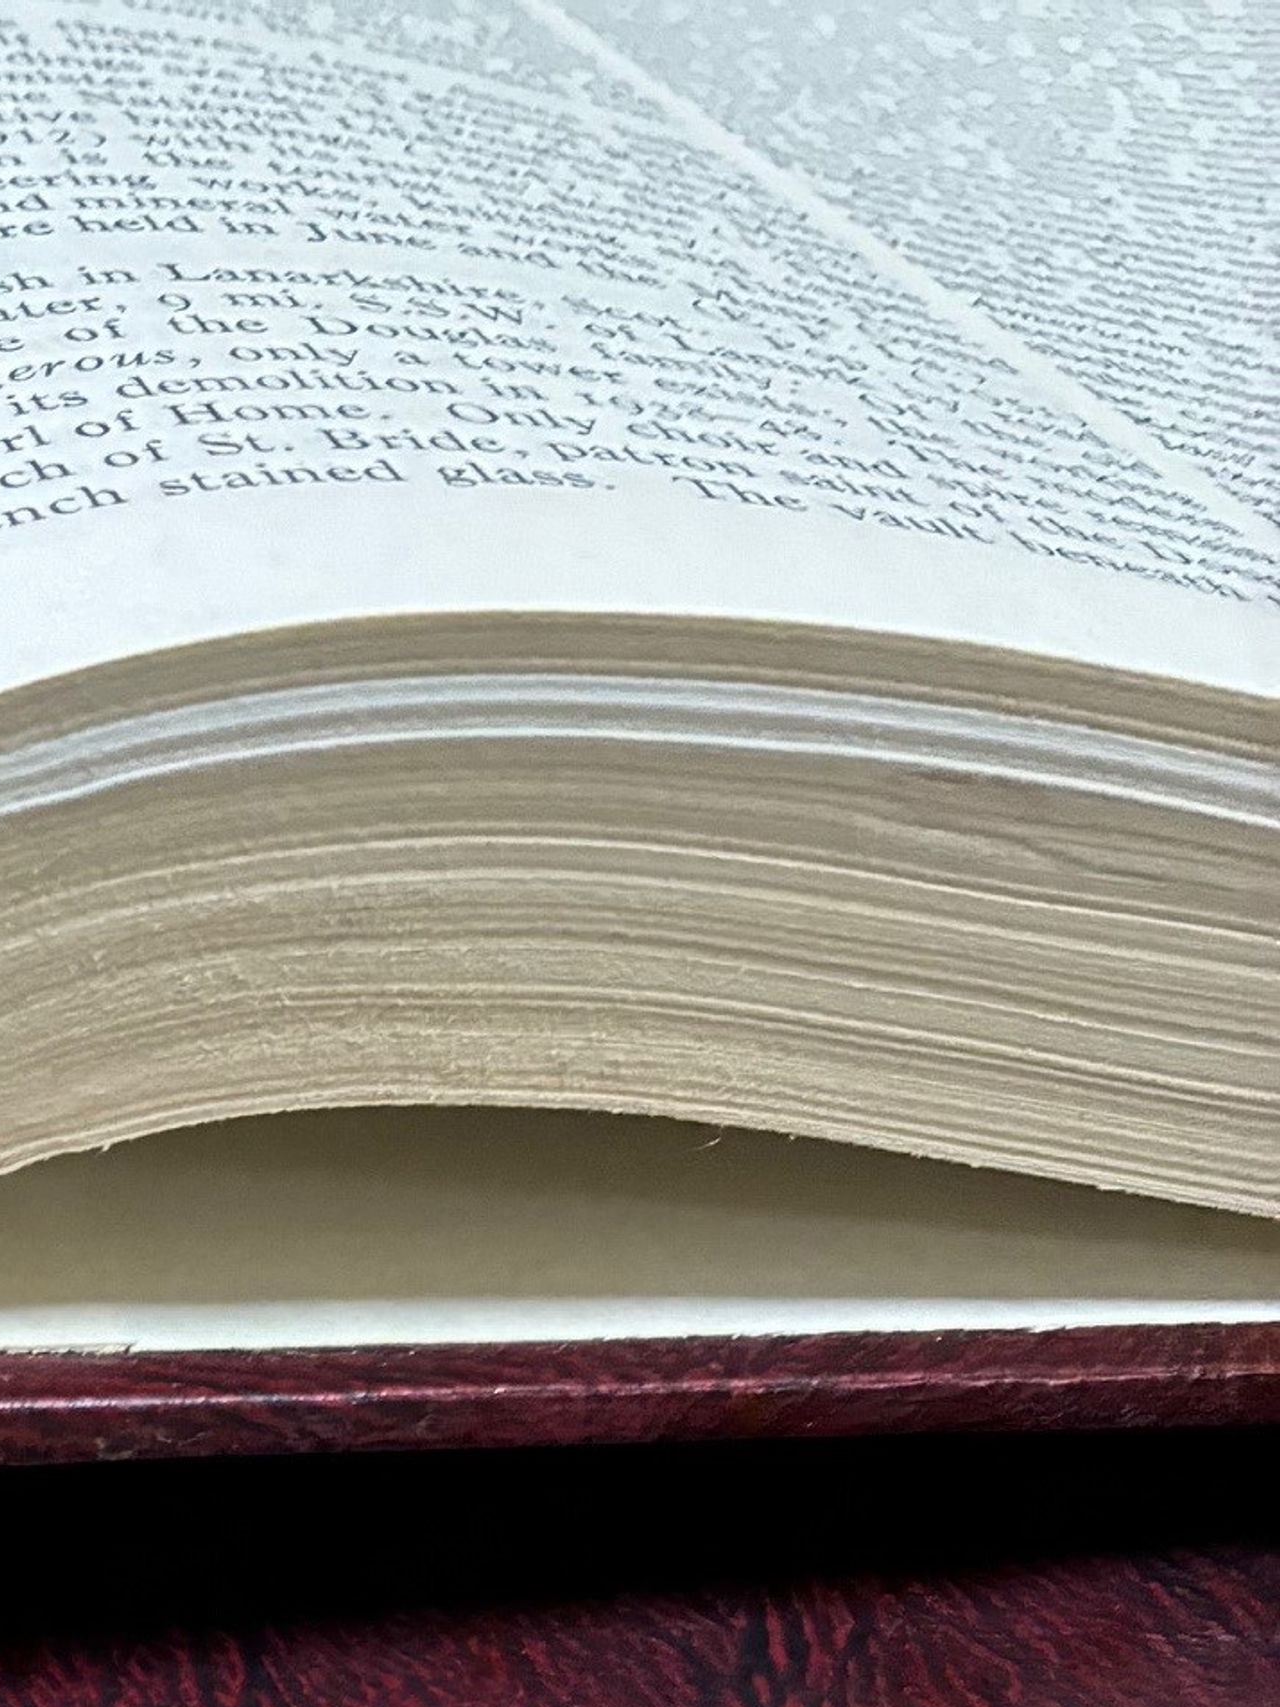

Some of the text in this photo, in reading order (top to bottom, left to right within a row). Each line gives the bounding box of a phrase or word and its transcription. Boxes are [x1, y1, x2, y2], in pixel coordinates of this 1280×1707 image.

[72, 192, 295, 216] mineral
[68, 213, 205, 235] held
[218, 216, 281, 236] in
[297, 220, 437, 250] June
[77, 265, 142, 285] in
[156, 263, 544, 309] Lanarkshire,
[156, 292, 192, 312] 9
[220, 289, 324, 309] mi.
[62, 317, 129, 343] of
[166, 312, 269, 336] the
[301, 312, 558, 354] Douglas
[227, 341, 360, 367] only
[392, 349, 432, 366] a
[451, 350, 624, 384] tower
[5, 388, 90, 417] its
[114, 368, 462, 400] demolition
[480, 375, 550, 401] in
[73, 409, 143, 439] of
[162, 399, 395, 427] Home.
[444, 400, 597, 437] Only
[626, 420, 780, 456] choir
[799, 448, 912, 479] and
[103, 439, 171, 469] of
[197, 432, 296, 457] St.
[318, 426, 531, 460] Bride,
[545, 438, 760, 479] patron
[948, 500, 1007, 525] of
[158, 458, 406, 497] stained
[435, 460, 618, 491] glass.
[671, 475, 809, 512] The
[827, 503, 995, 545] vault
